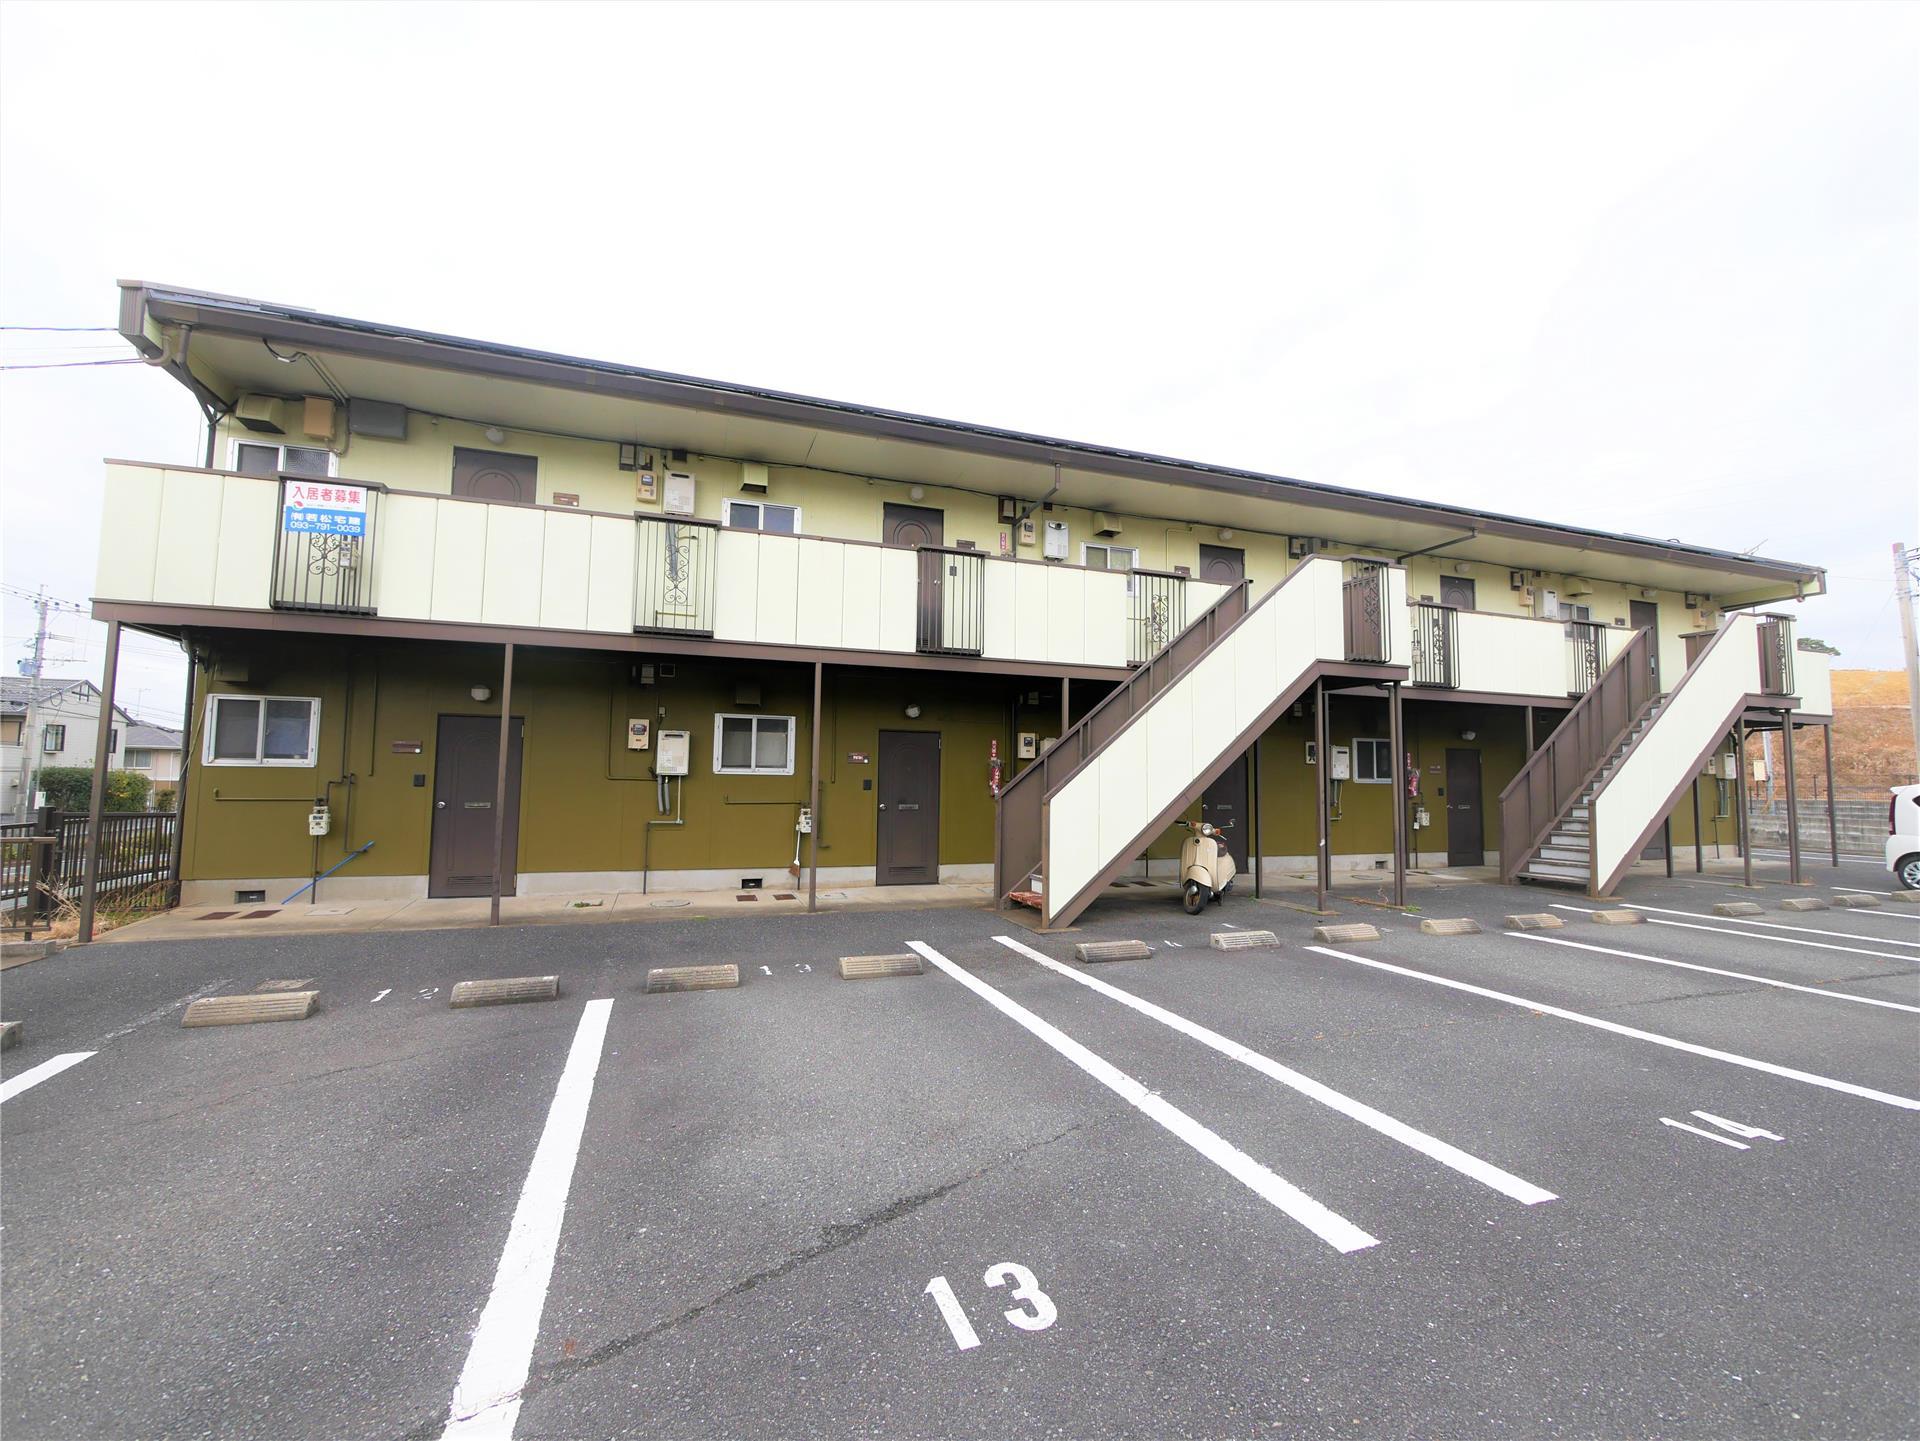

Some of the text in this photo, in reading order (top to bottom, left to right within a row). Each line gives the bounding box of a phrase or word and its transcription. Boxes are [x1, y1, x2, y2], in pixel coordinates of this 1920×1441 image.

[292, 486, 361, 504] 入居者募集
[290, 520, 361, 533] 093-791-0039
[1658, 1110, 1786, 1150] 14
[924, 1262, 1058, 1350] 13
